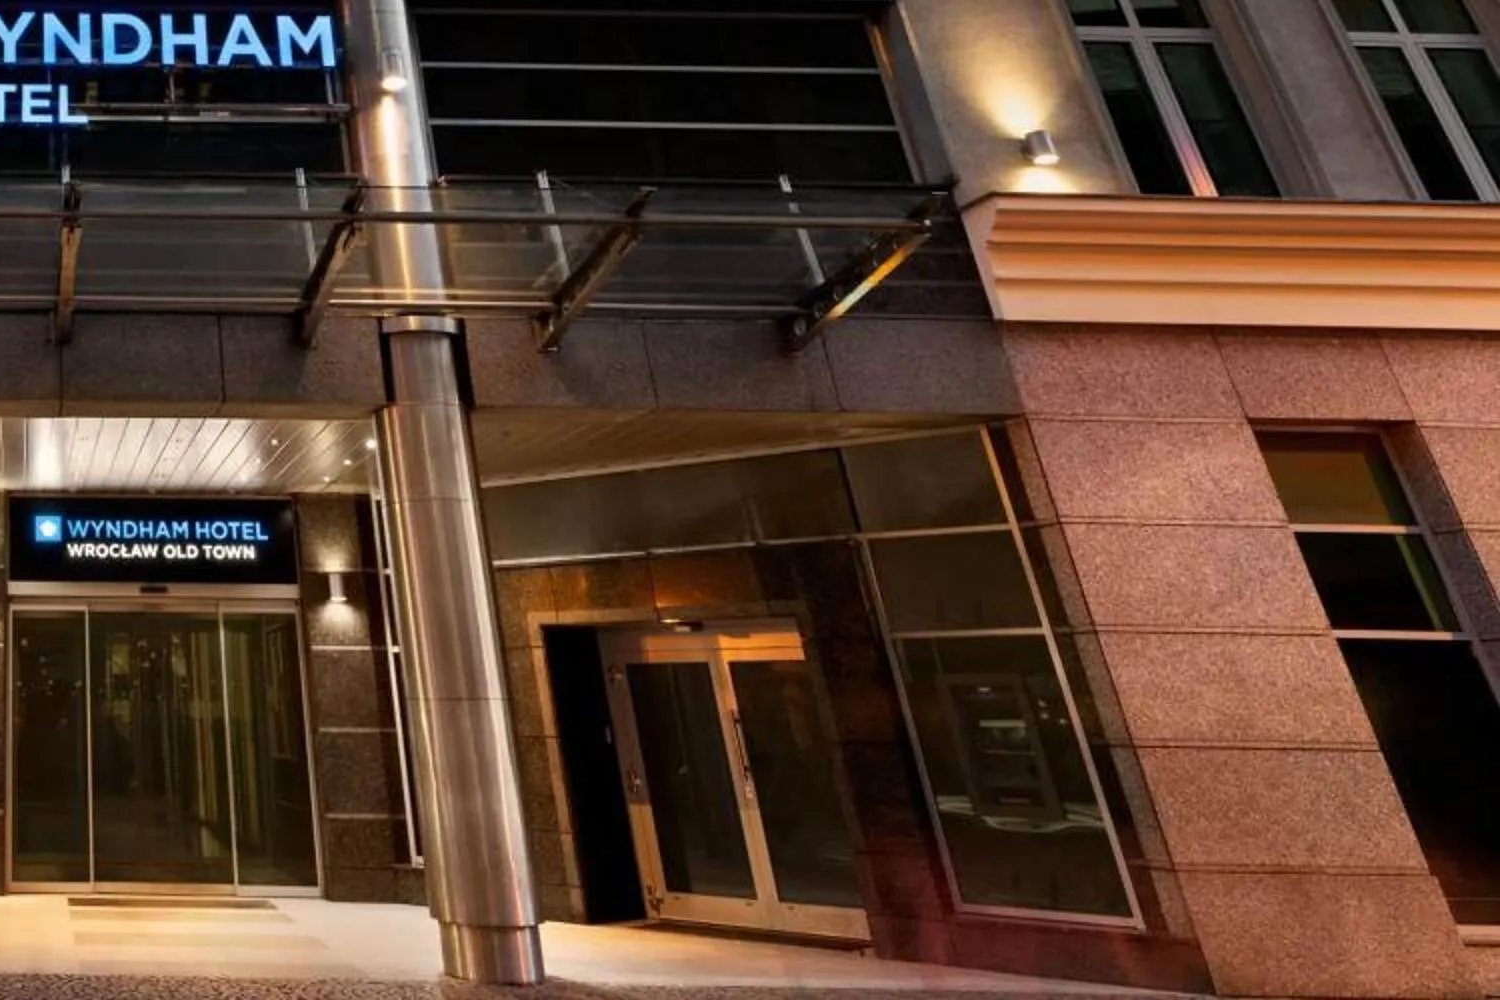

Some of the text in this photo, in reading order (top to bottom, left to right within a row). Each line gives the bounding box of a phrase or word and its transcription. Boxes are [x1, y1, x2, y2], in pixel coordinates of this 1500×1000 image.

[66, 519, 269, 541] WYNDHAM HOTEL
[66, 543, 257, 560] WROCŁAW OLD TOWN
